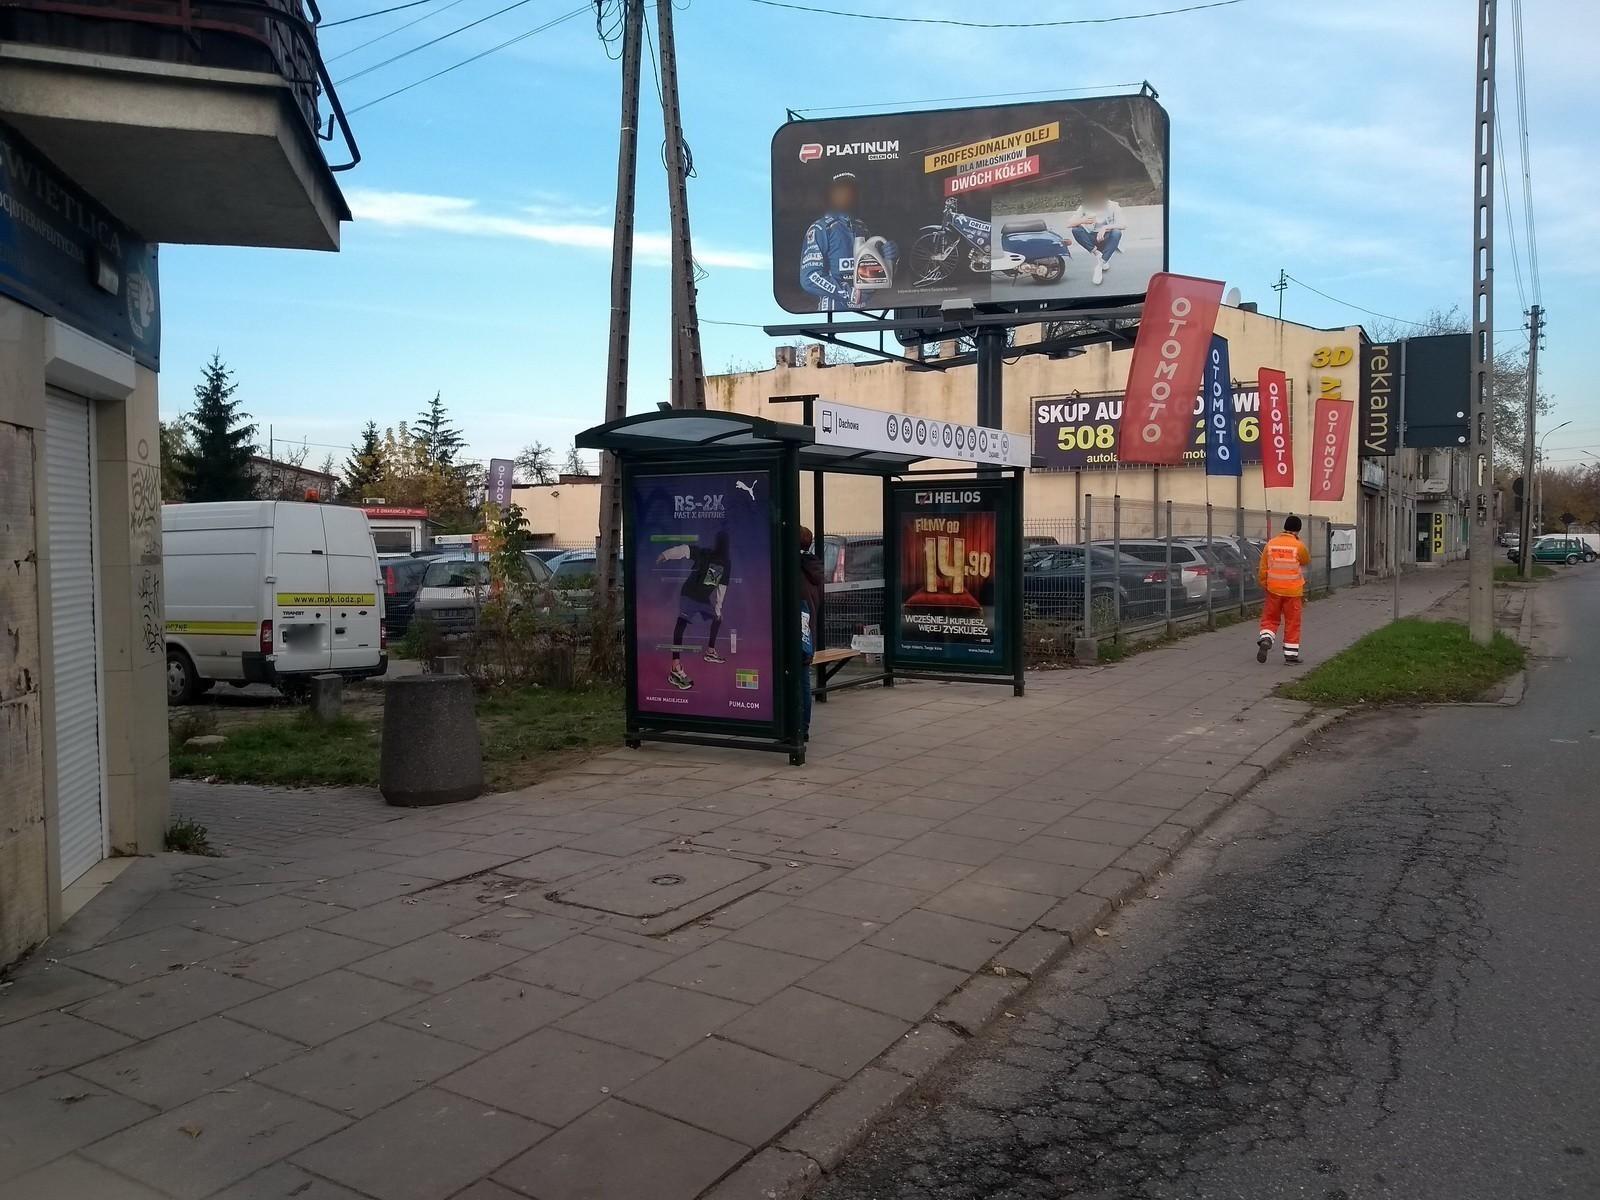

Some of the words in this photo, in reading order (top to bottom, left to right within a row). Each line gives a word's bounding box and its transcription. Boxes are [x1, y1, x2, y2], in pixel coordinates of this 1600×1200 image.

[826, 140, 899, 156] PLATINUM
[934, 135, 1022, 168] PROFESJONALNY
[1024, 128, 1050, 143] OLEJ
[960, 164, 975, 172] DLA
[975, 150, 1023, 168] MIŁOŚNIKÓW
[951, 171, 992, 192] DWÓCH
[995, 160, 1032, 181] KÓŁEK
[0, 140, 121, 256] WIETLICA
[969, 221, 990, 231] ORLEN
[811, 274, 834, 292] ORLEN
[1311, 347, 1353, 368] 3D
[1142, 297, 1191, 443] OTOMOTO
[1212, 349, 1230, 460] OTOMOTO
[1365, 345, 1392, 453] reklamy
[838, 417, 859, 430] Dachowa
[1038, 403, 1090, 424] SKUP
[1095, 401, 1124, 421] AU
[1058, 425, 1114, 450] 508
[1269, 383, 1287, 474] OTOMOTO
[1321, 410, 1339, 490] OTOMOTO
[496, 465, 506, 503] OTOMO
[674, 495, 725, 511] RS-2K
[935, 491, 981, 503] HELIOS
[915, 518, 946, 532] FILMY
[947, 521, 960, 533] OD
[1434, 513, 1442, 552] BHP
[294, 595, 364, 604] www.mpk.lodz.pl
[905, 614, 948, 625] WCZEŚNIEJ
[918, 624, 942, 633] WIĘCEJ
[943, 626, 988, 636] ZYSKUJESZ
[728, 700, 760, 709] PUMA.COM
